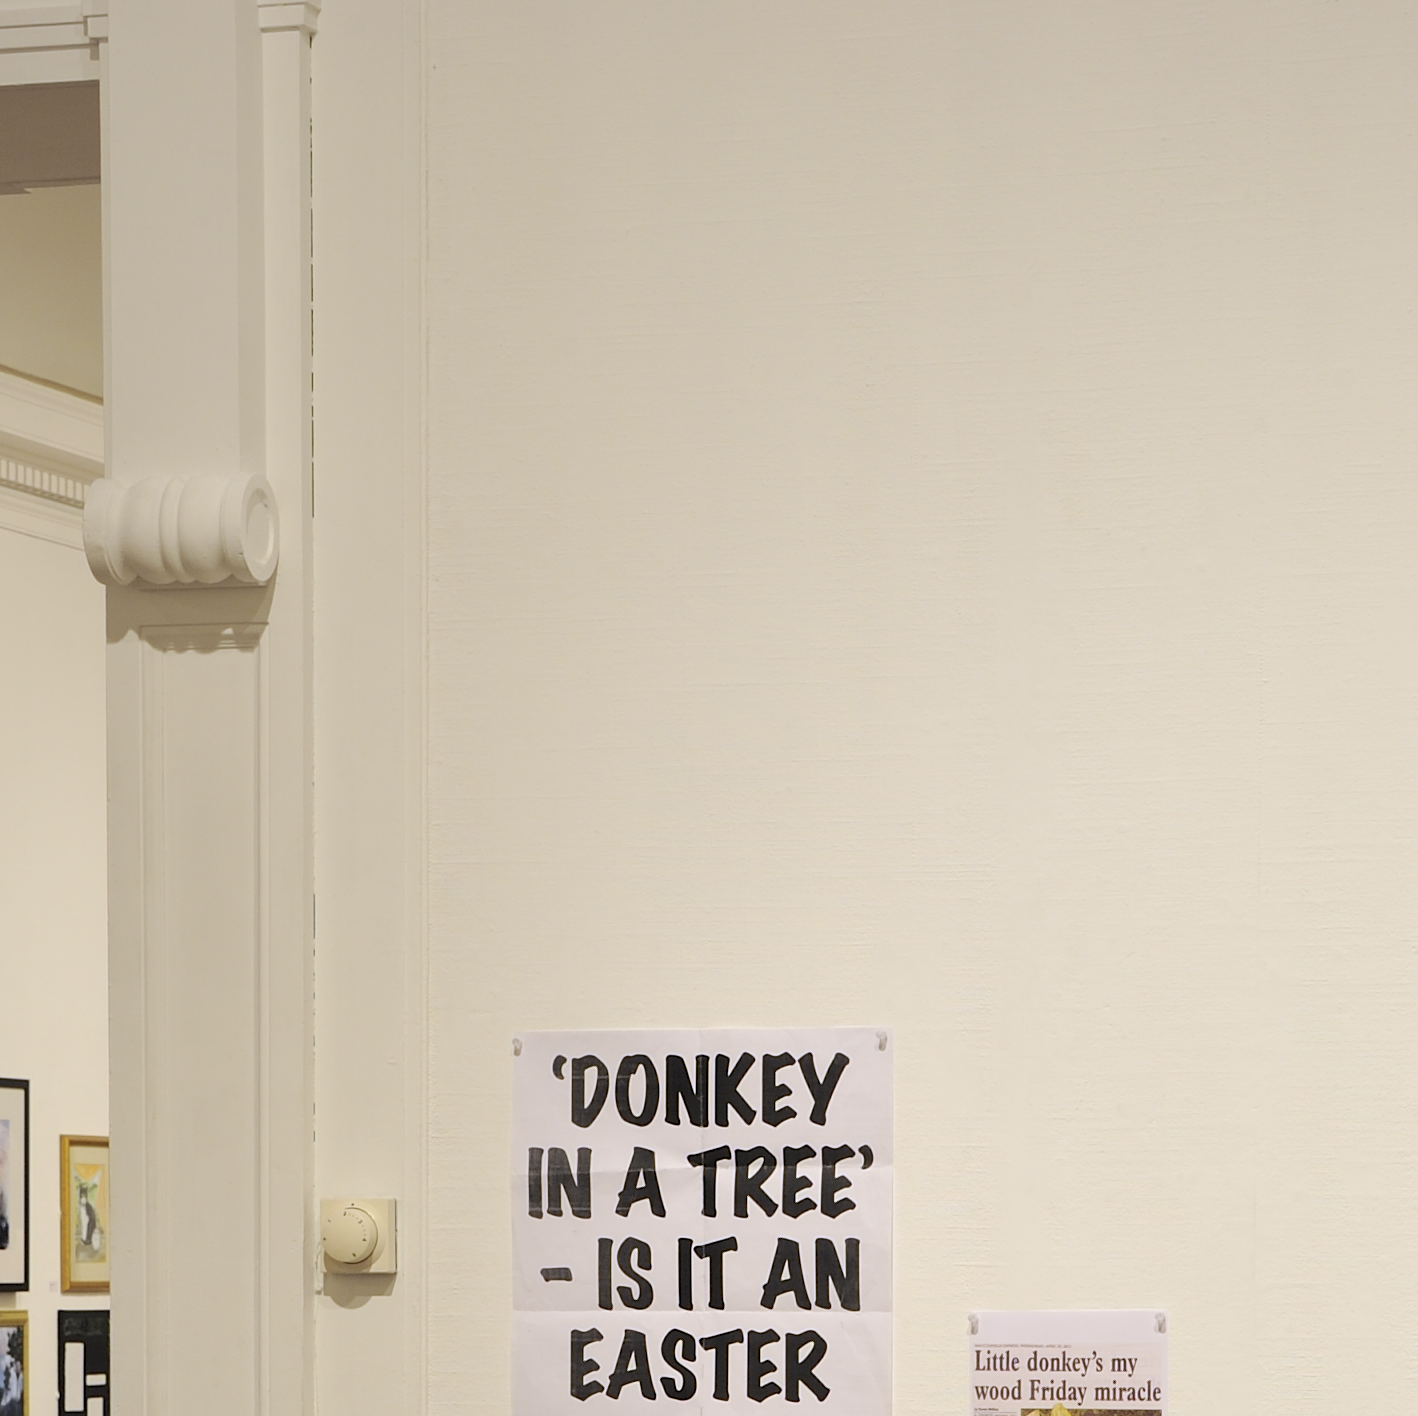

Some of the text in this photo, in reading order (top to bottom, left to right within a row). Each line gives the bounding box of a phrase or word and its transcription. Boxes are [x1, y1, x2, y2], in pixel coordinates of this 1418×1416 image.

[552, 1051, 850, 1129] 'DONKEY
[527, 1143, 874, 1220] IN A TREE'
[597, 1236, 654, 1311] IS
[677, 1236, 739, 1312] IT
[759, 1237, 861, 1312] AN
[570, 1327, 831, 1403] EASTER
[974, 1349, 1138, 1377] Little donkey's my
[974, 1379, 1162, 1406] wood Friday miracle
